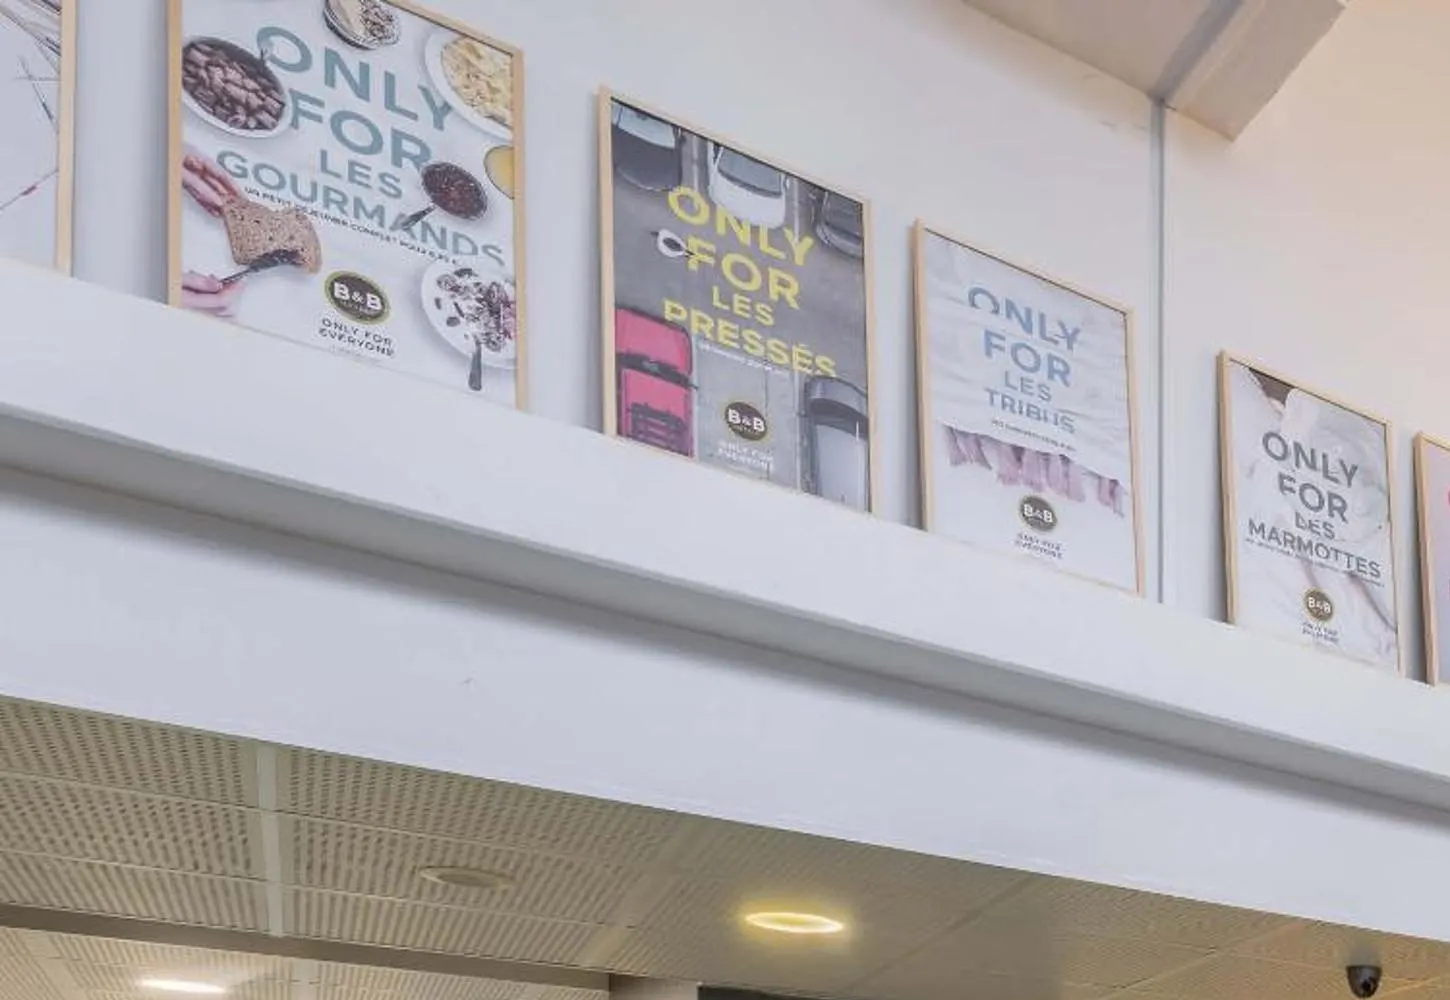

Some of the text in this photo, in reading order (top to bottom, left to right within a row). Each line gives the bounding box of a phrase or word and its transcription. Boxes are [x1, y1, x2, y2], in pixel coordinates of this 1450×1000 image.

[256, 26, 453, 132] ONLY
[288, 88, 432, 173] FOR
[319, 150, 403, 199] LES
[216, 150, 507, 266] GOURMANDS
[668, 186, 816, 266] ONLY
[333, 281, 382, 311] B&B
[686, 235, 801, 309] FOR
[321, 318, 393, 346] ONLY FOR
[712, 286, 775, 326] LES
[967, 286, 1082, 351] ONLY
[318, 327, 395, 358] EVERYONE
[664, 298, 838, 378] PRESSÉS
[983, 329, 1071, 388] FOR
[985, 388, 1077, 435] TRIBUS
[1004, 371, 1052, 401] LES
[728, 407, 765, 433] B&B
[1262, 431, 1359, 489] ONLY
[1277, 471, 1349, 523] FOR
[1248, 519, 1382, 580] MARMOTTES
[1294, 511, 1336, 541] LES
